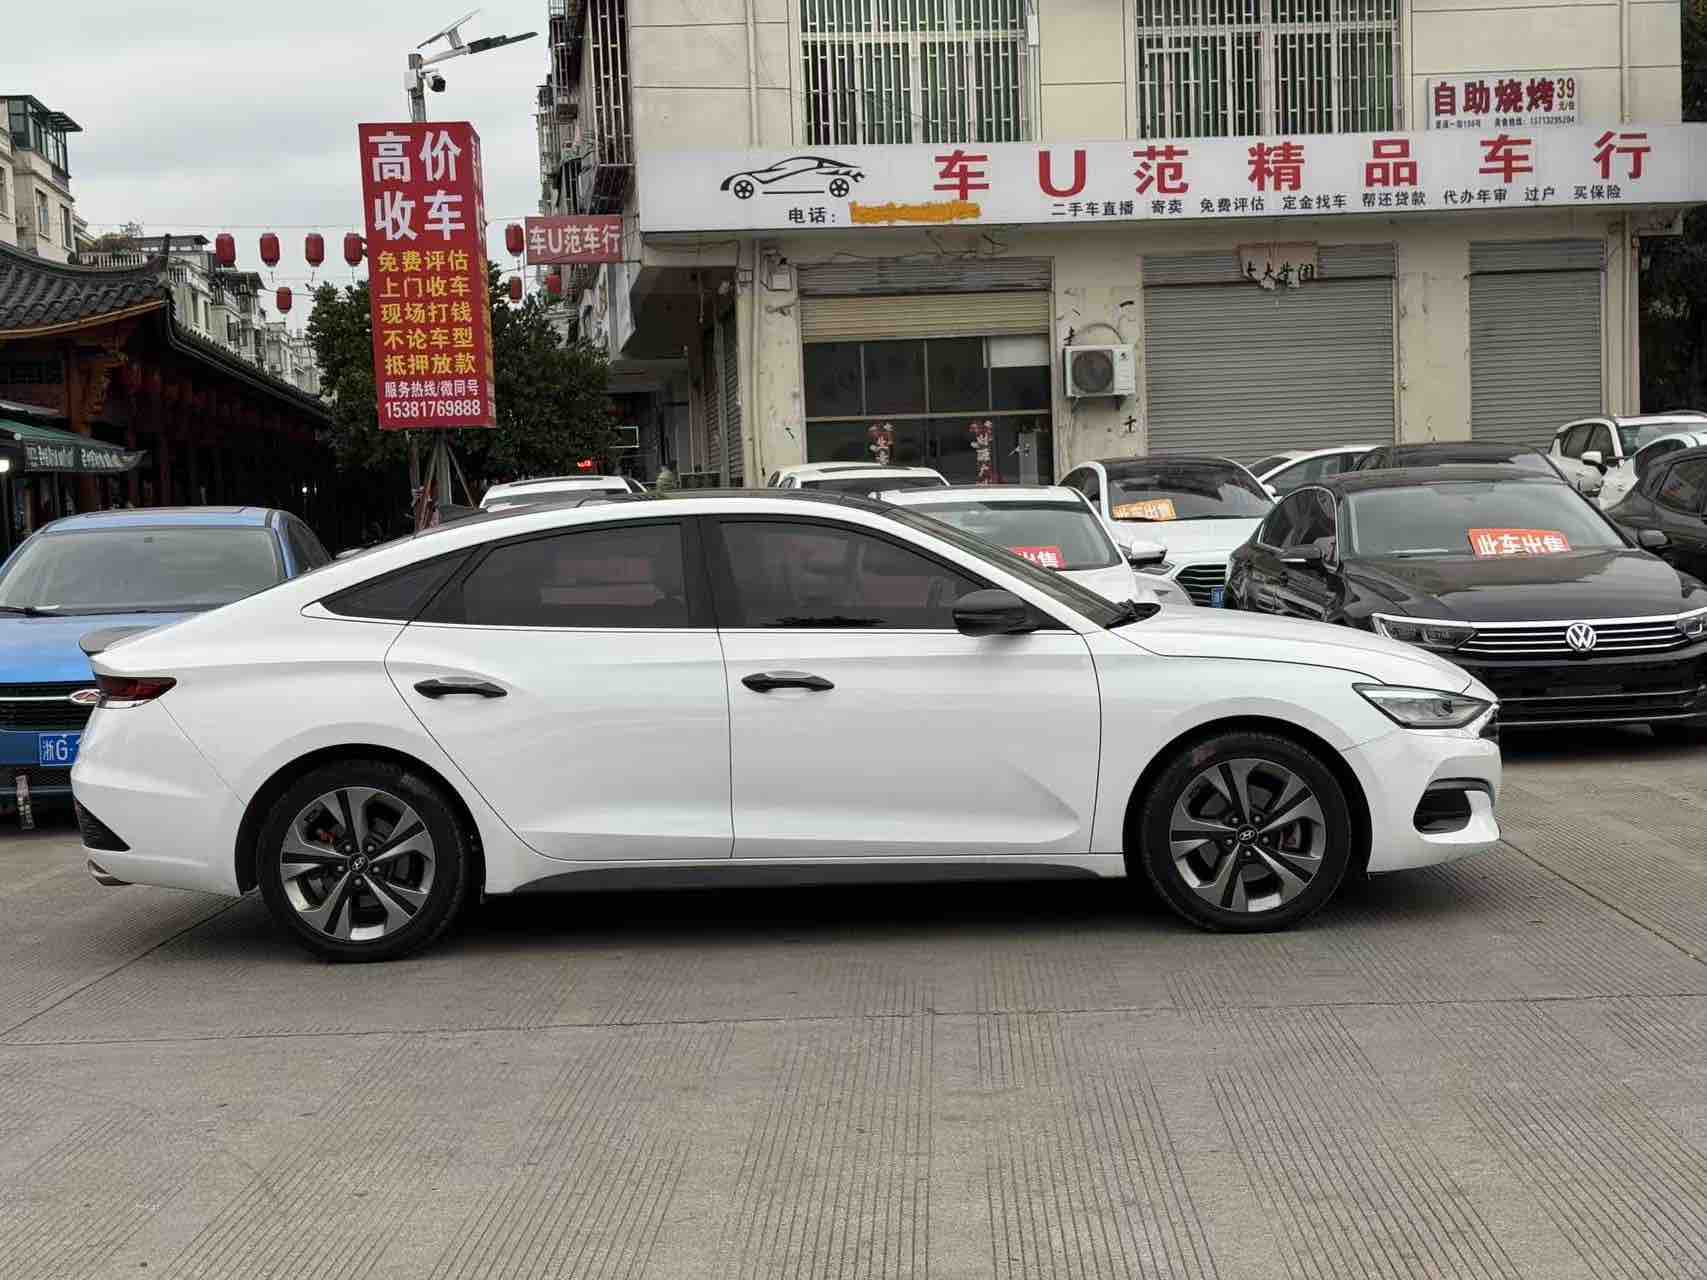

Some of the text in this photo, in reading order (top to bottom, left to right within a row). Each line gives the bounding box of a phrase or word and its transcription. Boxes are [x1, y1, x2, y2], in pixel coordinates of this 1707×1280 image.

[1435, 78, 1554, 116] 自助烧烤
[1557, 78, 1575, 98] 39
[368, 131, 462, 182] 高价
[933, 130, 1651, 200] 车U范精品车行
[1052, 184, 1621, 217] 二手车直播 寄卖 免费评估 定金找车 帮还贷款 代办年审 过户 买保险
[374, 190, 465, 241] 收车
[528, 224, 621, 254] 车U范车行
[377, 250, 468, 273] 免费评估
[379, 275, 470, 298] 上门收车
[381, 301, 472, 324] 现场打钱
[383, 328, 474, 350] 不论车型
[384, 353, 475, 375] 抵押放款
[384, 379, 479, 397] 服务热线/微同号
[385, 399, 481, 418] 15381769888
[1477, 534, 1563, 556] 此车出售
